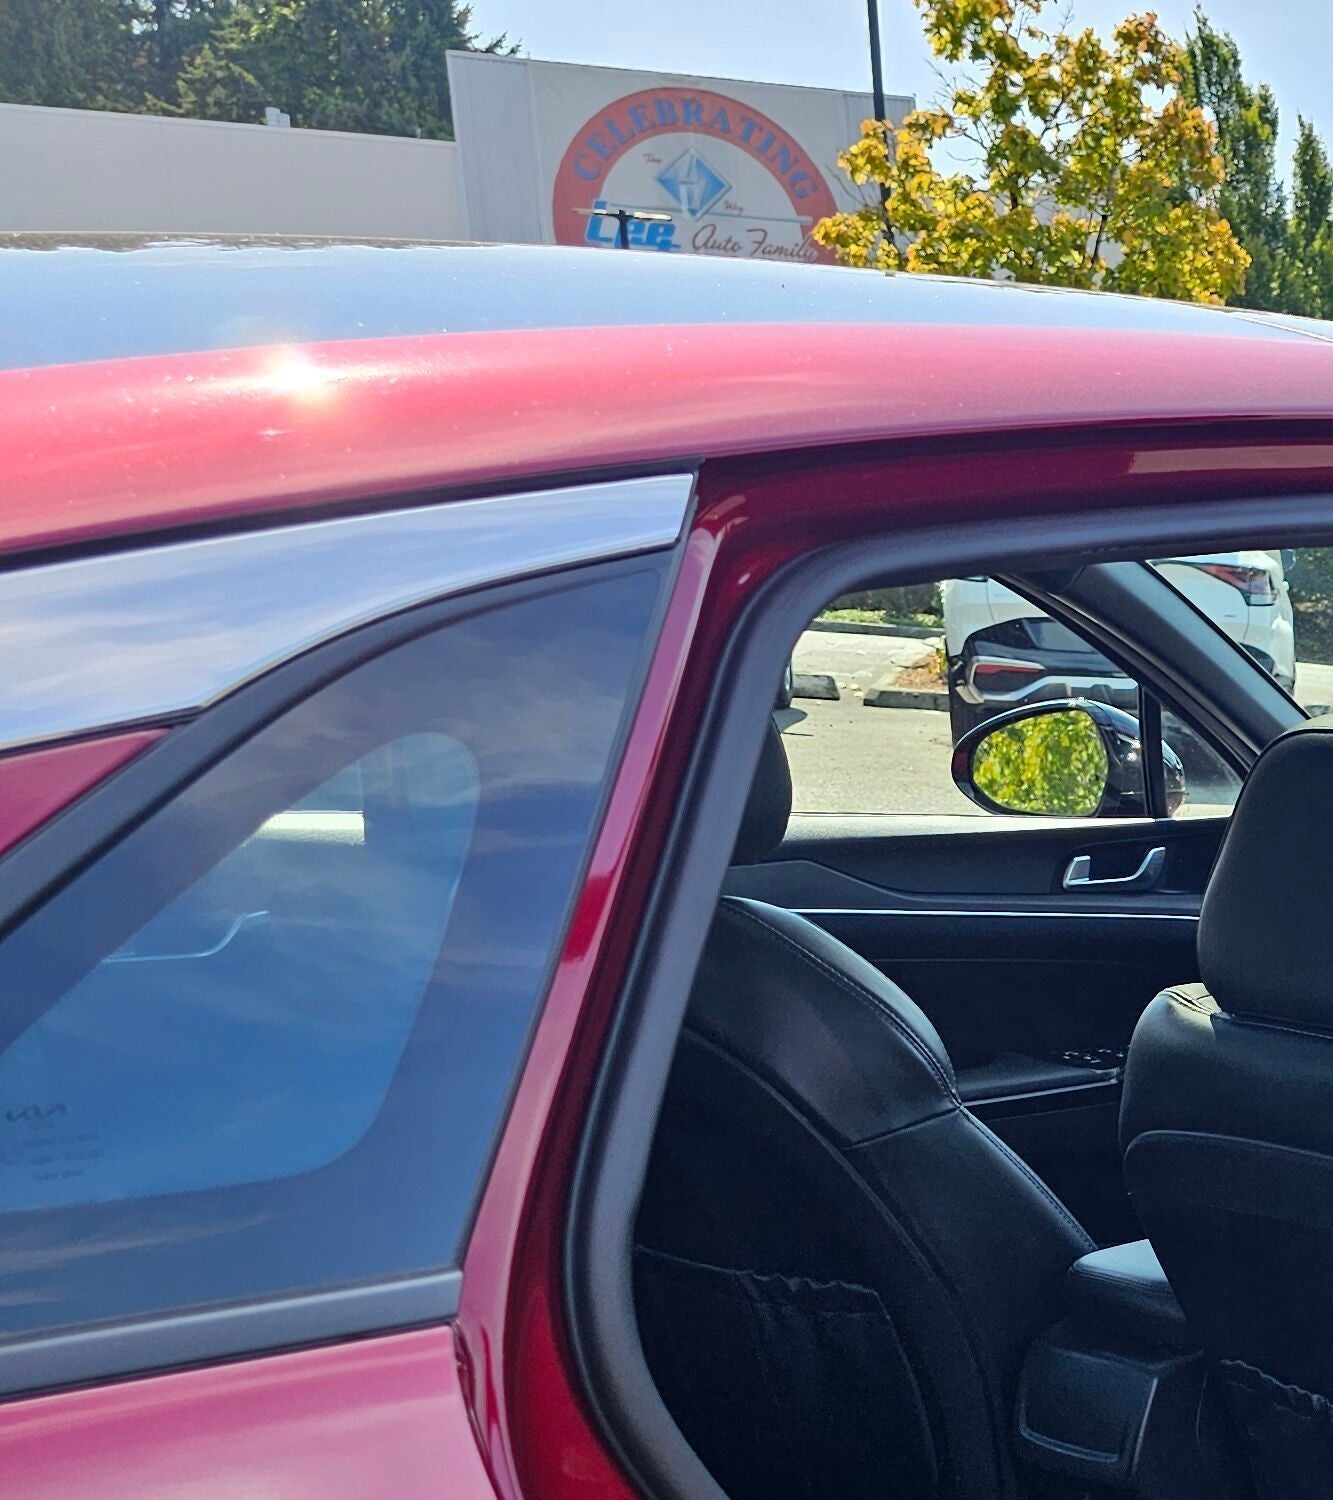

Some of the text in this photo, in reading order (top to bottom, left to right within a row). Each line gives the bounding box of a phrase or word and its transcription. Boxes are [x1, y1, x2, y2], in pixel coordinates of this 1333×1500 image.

[573, 97, 818, 200] CELEBRATING
[692, 224, 741, 252] Auto
[746, 228, 818, 262] Family
